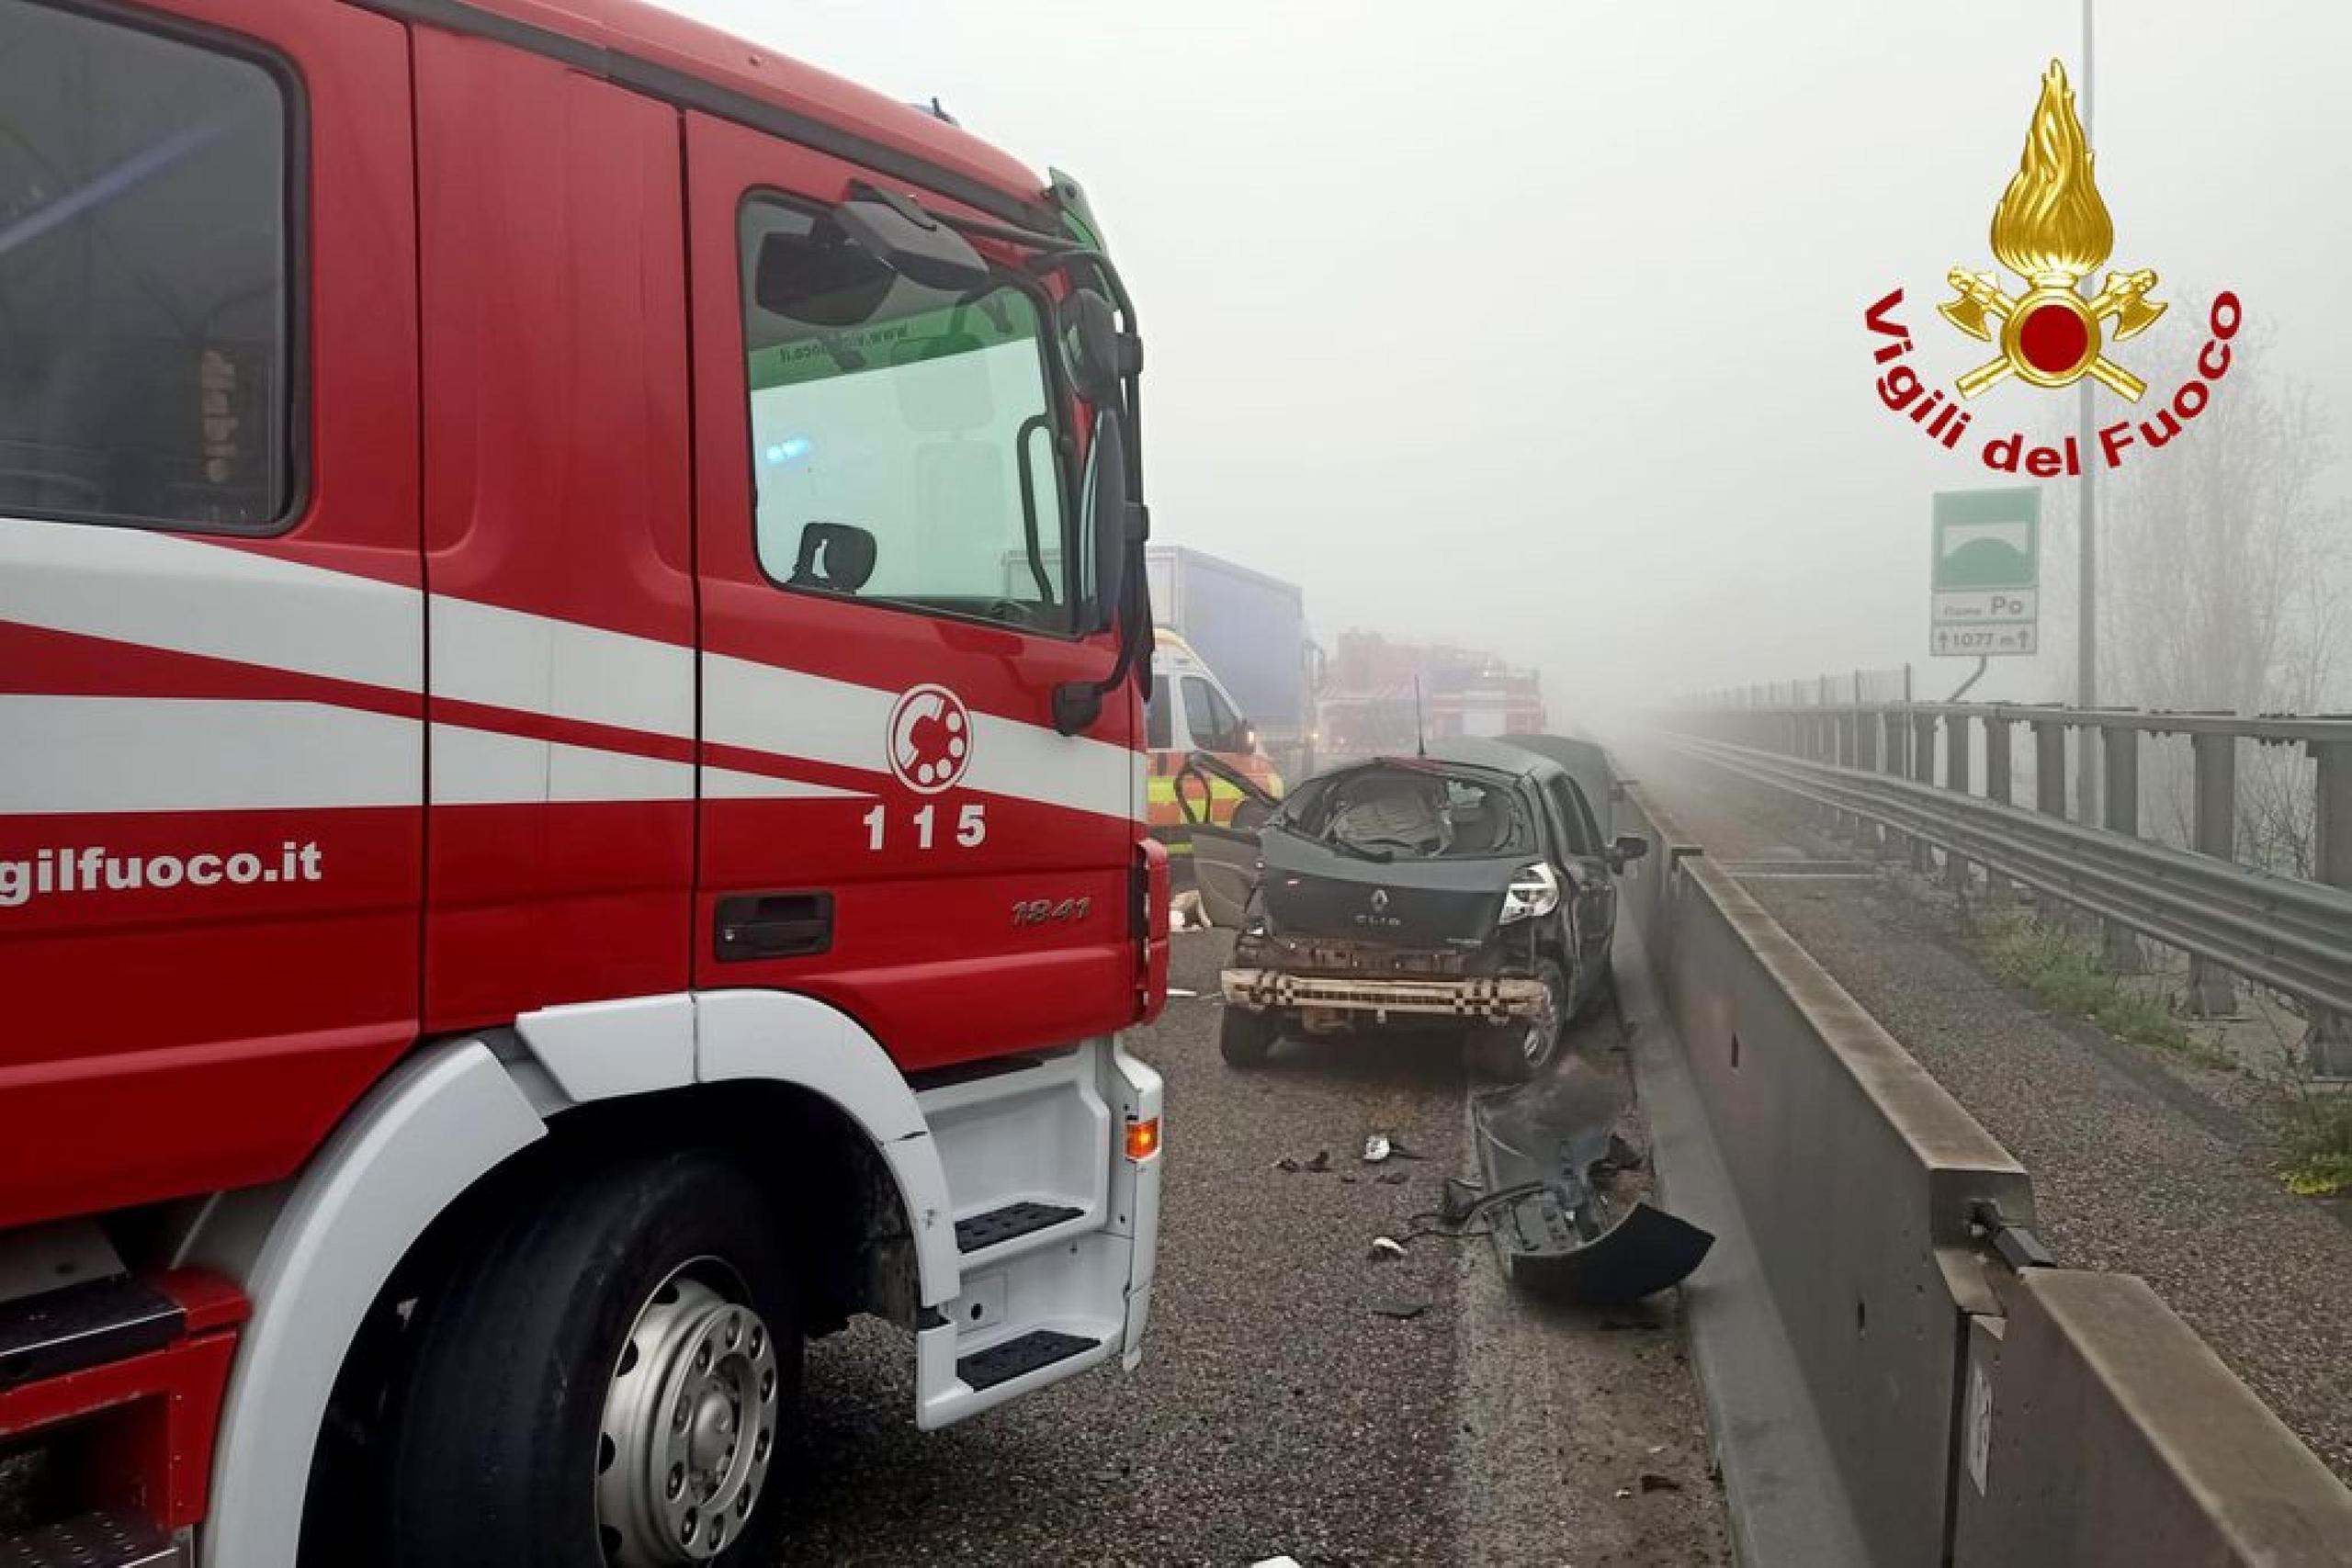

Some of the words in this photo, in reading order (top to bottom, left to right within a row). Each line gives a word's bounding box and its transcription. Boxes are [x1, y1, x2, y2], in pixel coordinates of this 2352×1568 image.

[1990, 595, 2023, 615] Po
[1953, 632, 1994, 646] 1077
[1012, 897, 1091, 926] 1841
